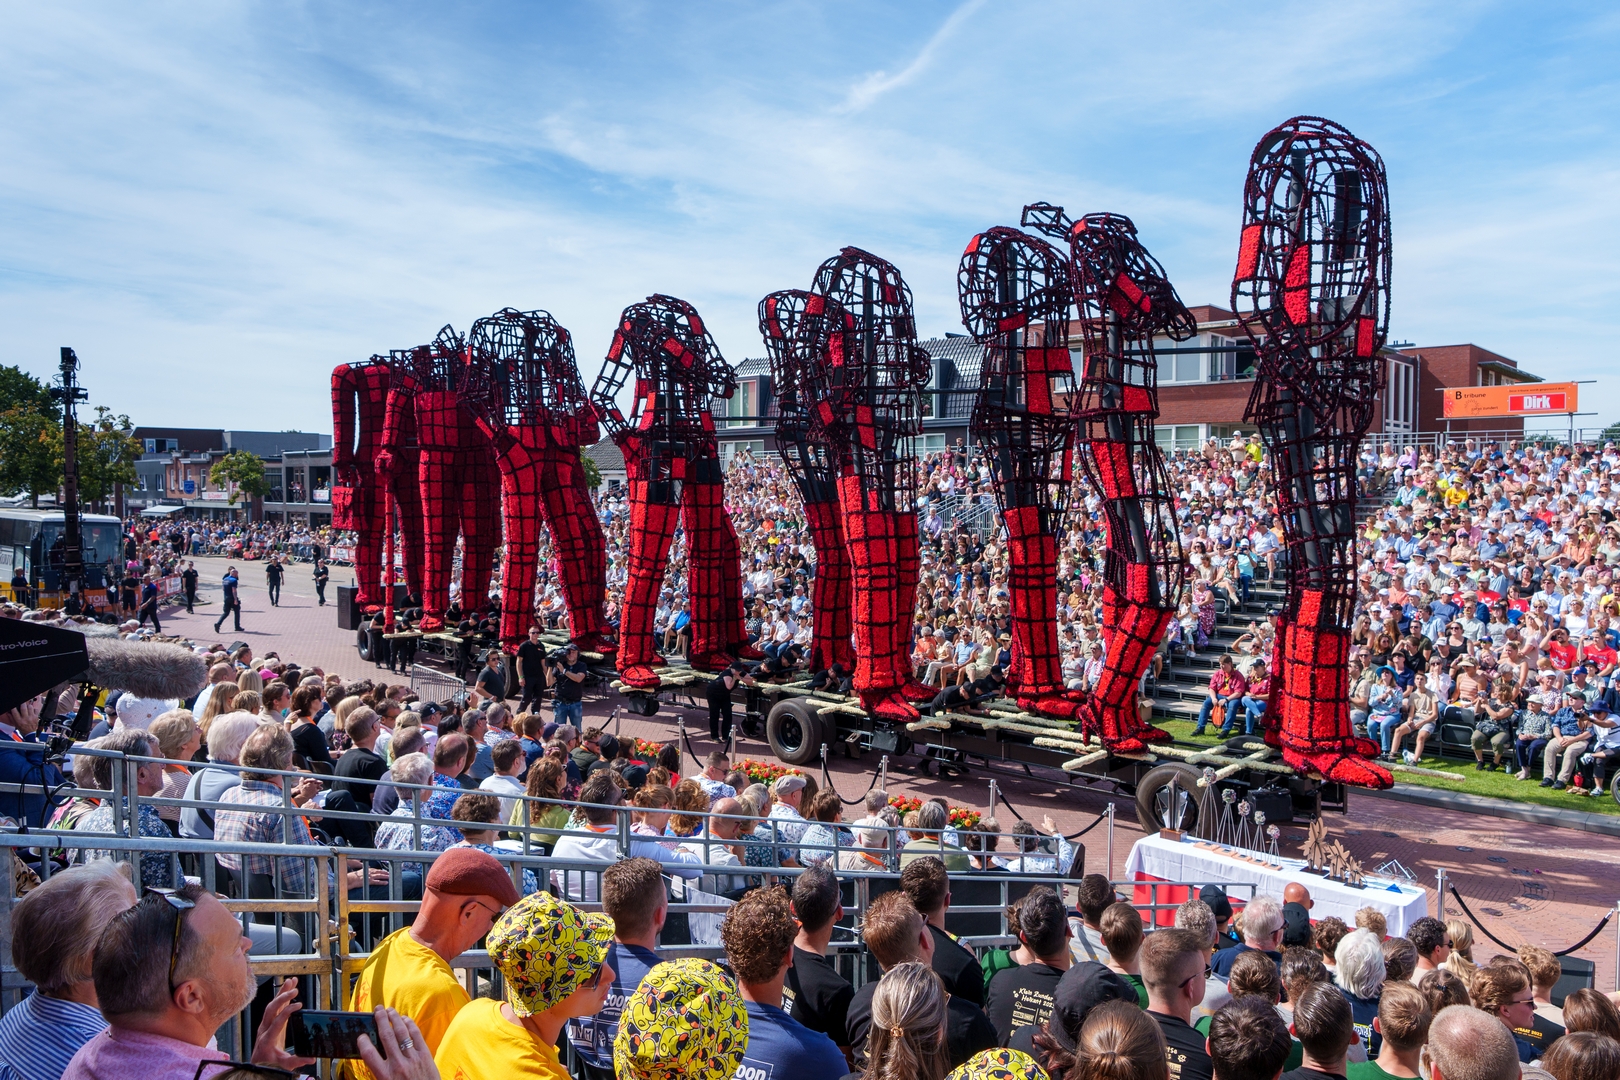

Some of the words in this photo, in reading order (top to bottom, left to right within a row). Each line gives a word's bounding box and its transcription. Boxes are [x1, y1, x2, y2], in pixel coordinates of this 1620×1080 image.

[1455, 391, 1462, 400] B
[1523, 395, 1551, 409] Dirk
[0, 639, 48, 651] tro-Voice
[1033, 991, 1053, 1001] Zunder
